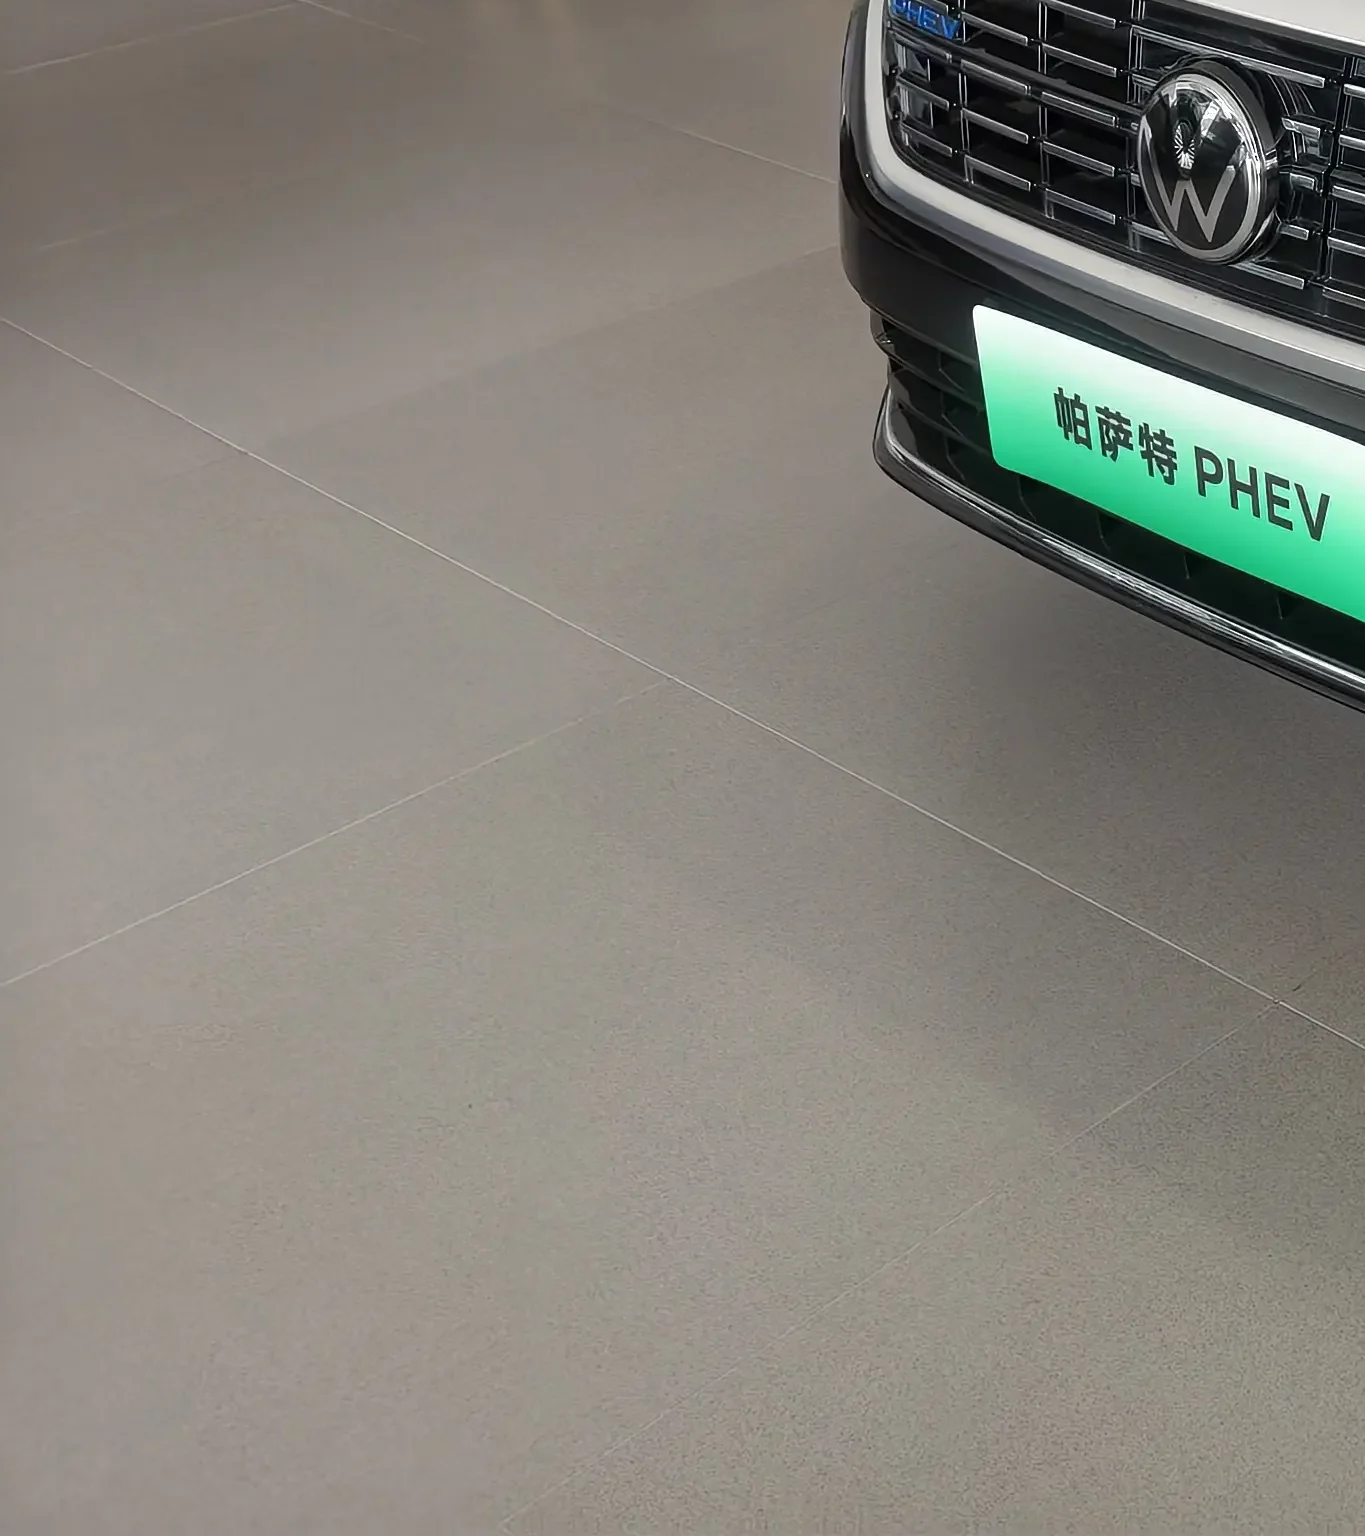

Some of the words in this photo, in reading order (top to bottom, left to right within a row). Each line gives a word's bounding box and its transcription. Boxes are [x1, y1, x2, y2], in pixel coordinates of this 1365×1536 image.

[1137, 72, 1262, 263] W
[1052, 386, 1178, 487] 帕萨特
[1195, 447, 1331, 542] PHEV
